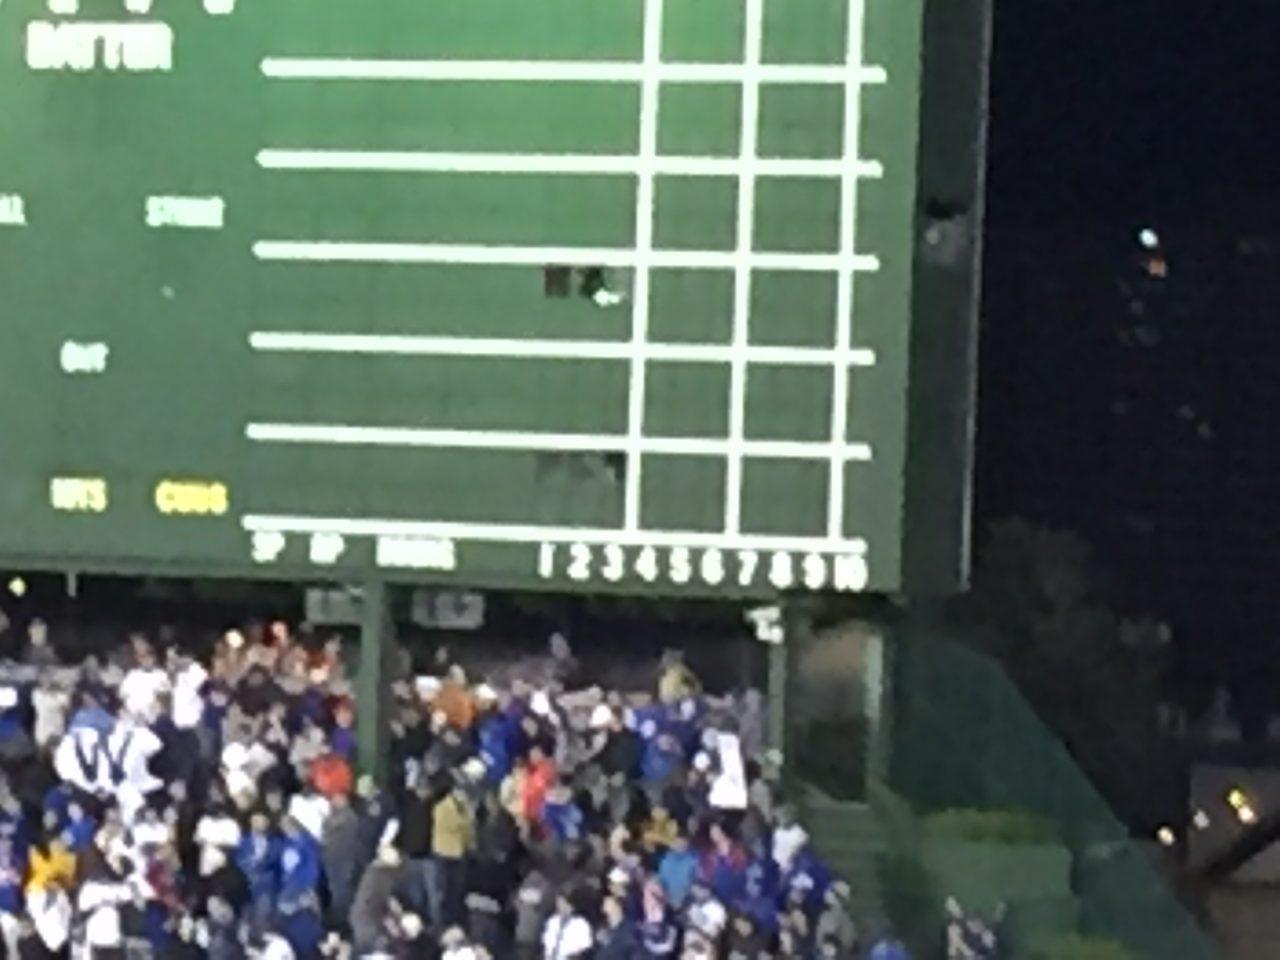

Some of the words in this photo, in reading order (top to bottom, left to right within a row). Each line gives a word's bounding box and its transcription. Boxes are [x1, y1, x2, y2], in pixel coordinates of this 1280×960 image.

[539, 542, 556, 579] 1
[569, 543, 592, 581] 2
[602, 543, 622, 582] 3
[635, 545, 657, 583] 4
[669, 546, 691, 584] 5
[701, 547, 724, 585] 6
[738, 550, 758, 586] 7
[770, 551, 792, 588] 8
[803, 552, 826, 590] 9
[834, 552, 867, 591] 10
[72, 728, 136, 785] W
